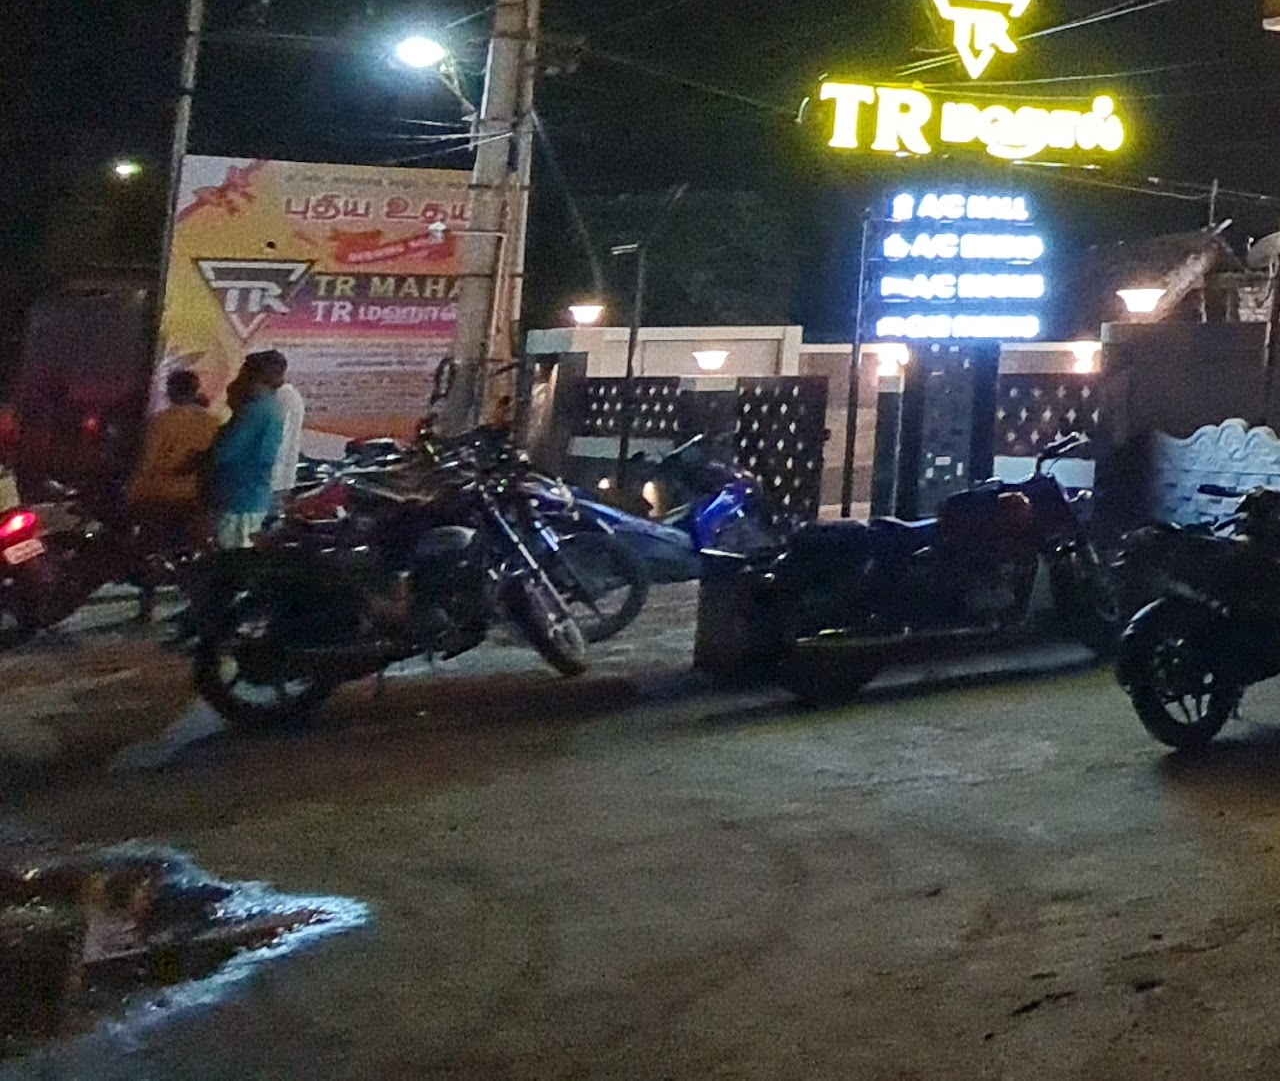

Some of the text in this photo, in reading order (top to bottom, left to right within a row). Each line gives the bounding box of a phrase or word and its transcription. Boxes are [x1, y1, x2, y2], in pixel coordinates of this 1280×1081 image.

[820, 82, 932, 154] TR
[285, 192, 471, 223] புதிய உதய
[313, 275, 461, 299] TR MAHA
[311, 300, 354, 323] TR
